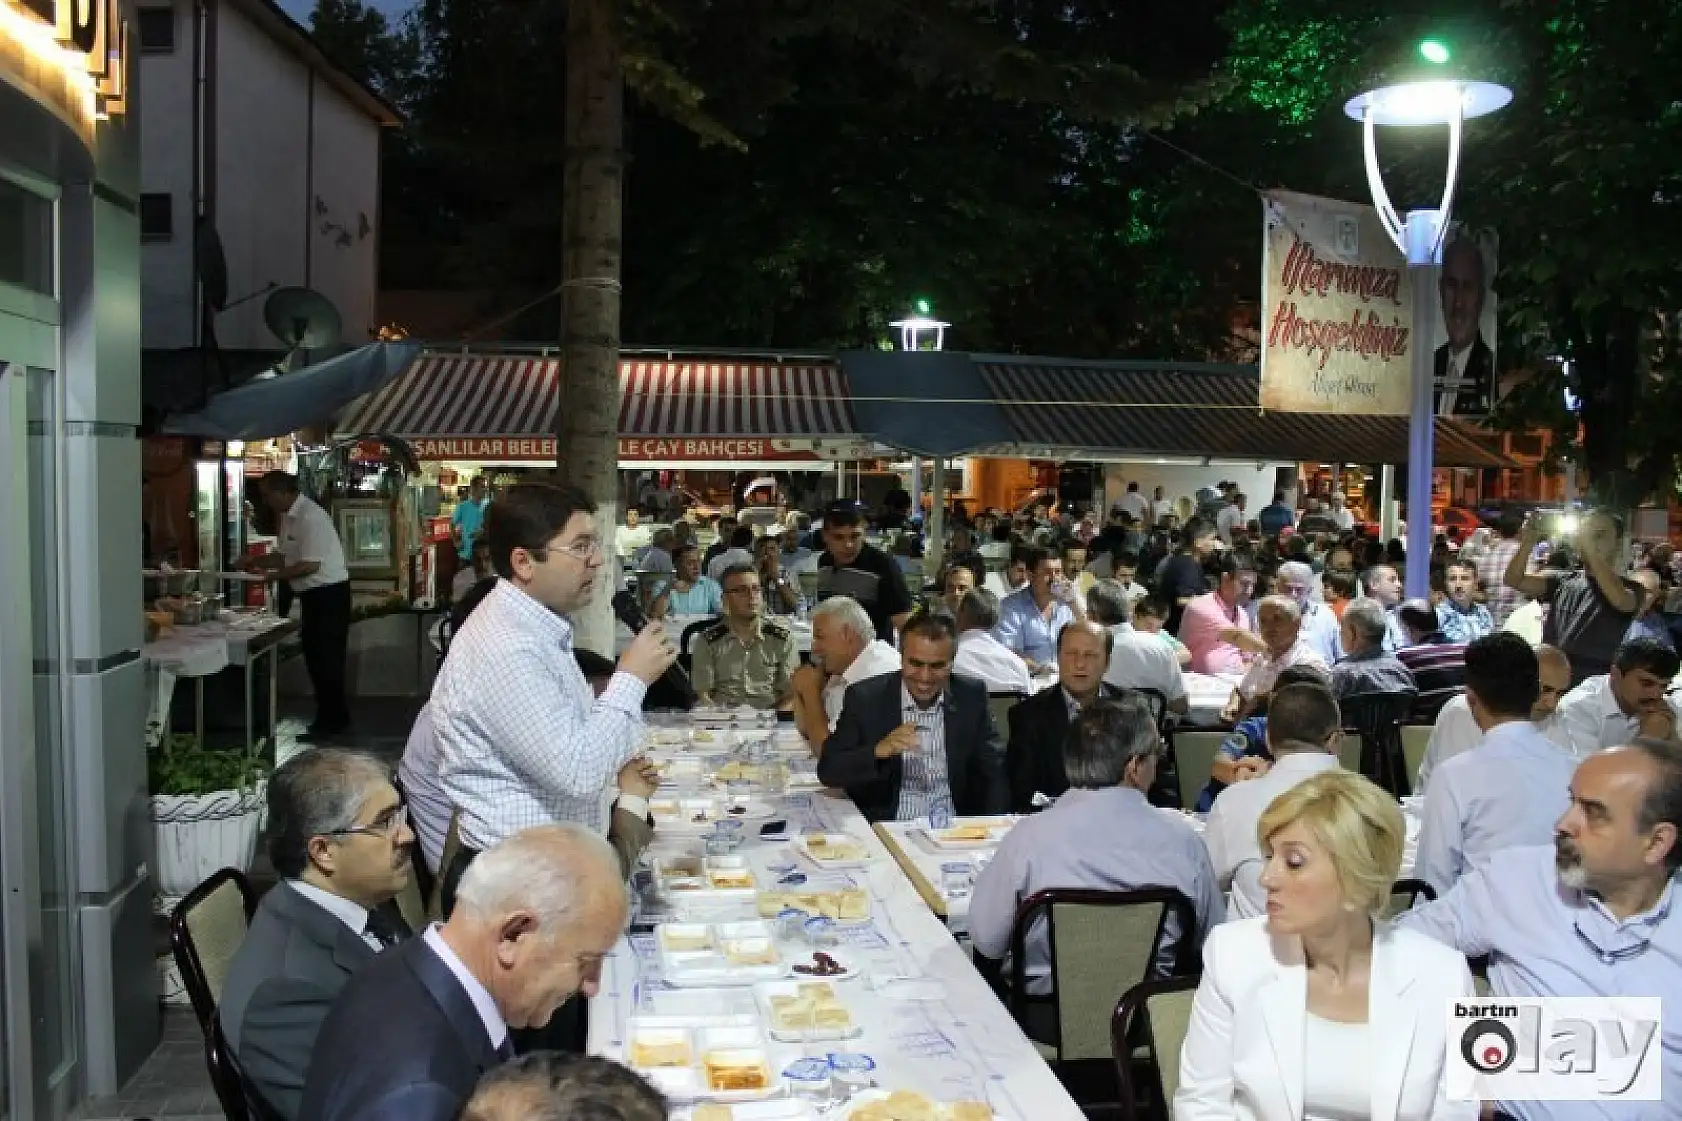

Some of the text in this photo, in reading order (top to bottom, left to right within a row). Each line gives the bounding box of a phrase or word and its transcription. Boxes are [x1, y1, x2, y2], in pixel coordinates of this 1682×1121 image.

[507, 439, 557, 455] BELE
[643, 439, 679, 459] ÇAY
[685, 438, 764, 459] BAHÇESİ
